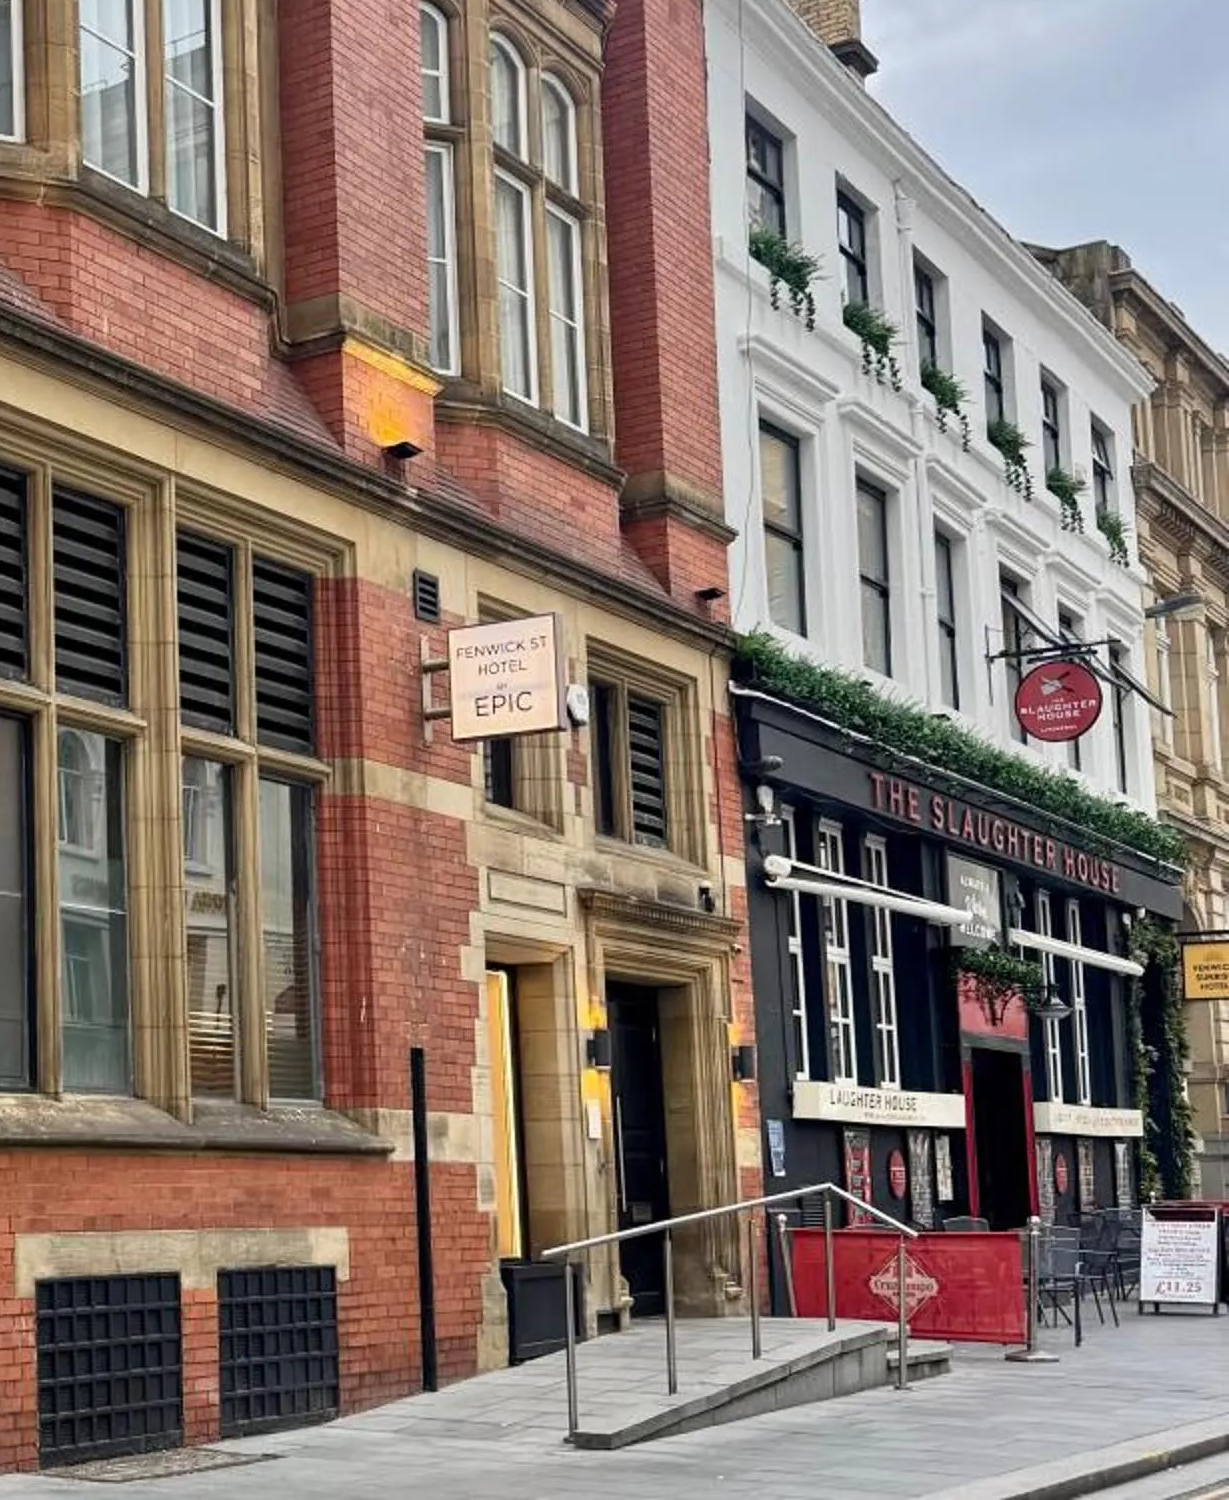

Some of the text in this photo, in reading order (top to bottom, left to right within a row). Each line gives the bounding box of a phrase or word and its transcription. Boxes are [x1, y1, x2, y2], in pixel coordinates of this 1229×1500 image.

[456, 636, 547, 660] FENWICK ST
[478, 660, 528, 676] HOTEL
[475, 691, 532, 717] EPIC
[1020, 699, 1096, 715] SLAUGHTER
[1037, 709, 1080, 721] HOUSE
[869, 771, 1120, 893] THE SLAUGHTER HOUSE
[885, 1095, 918, 1112] HOUSE
